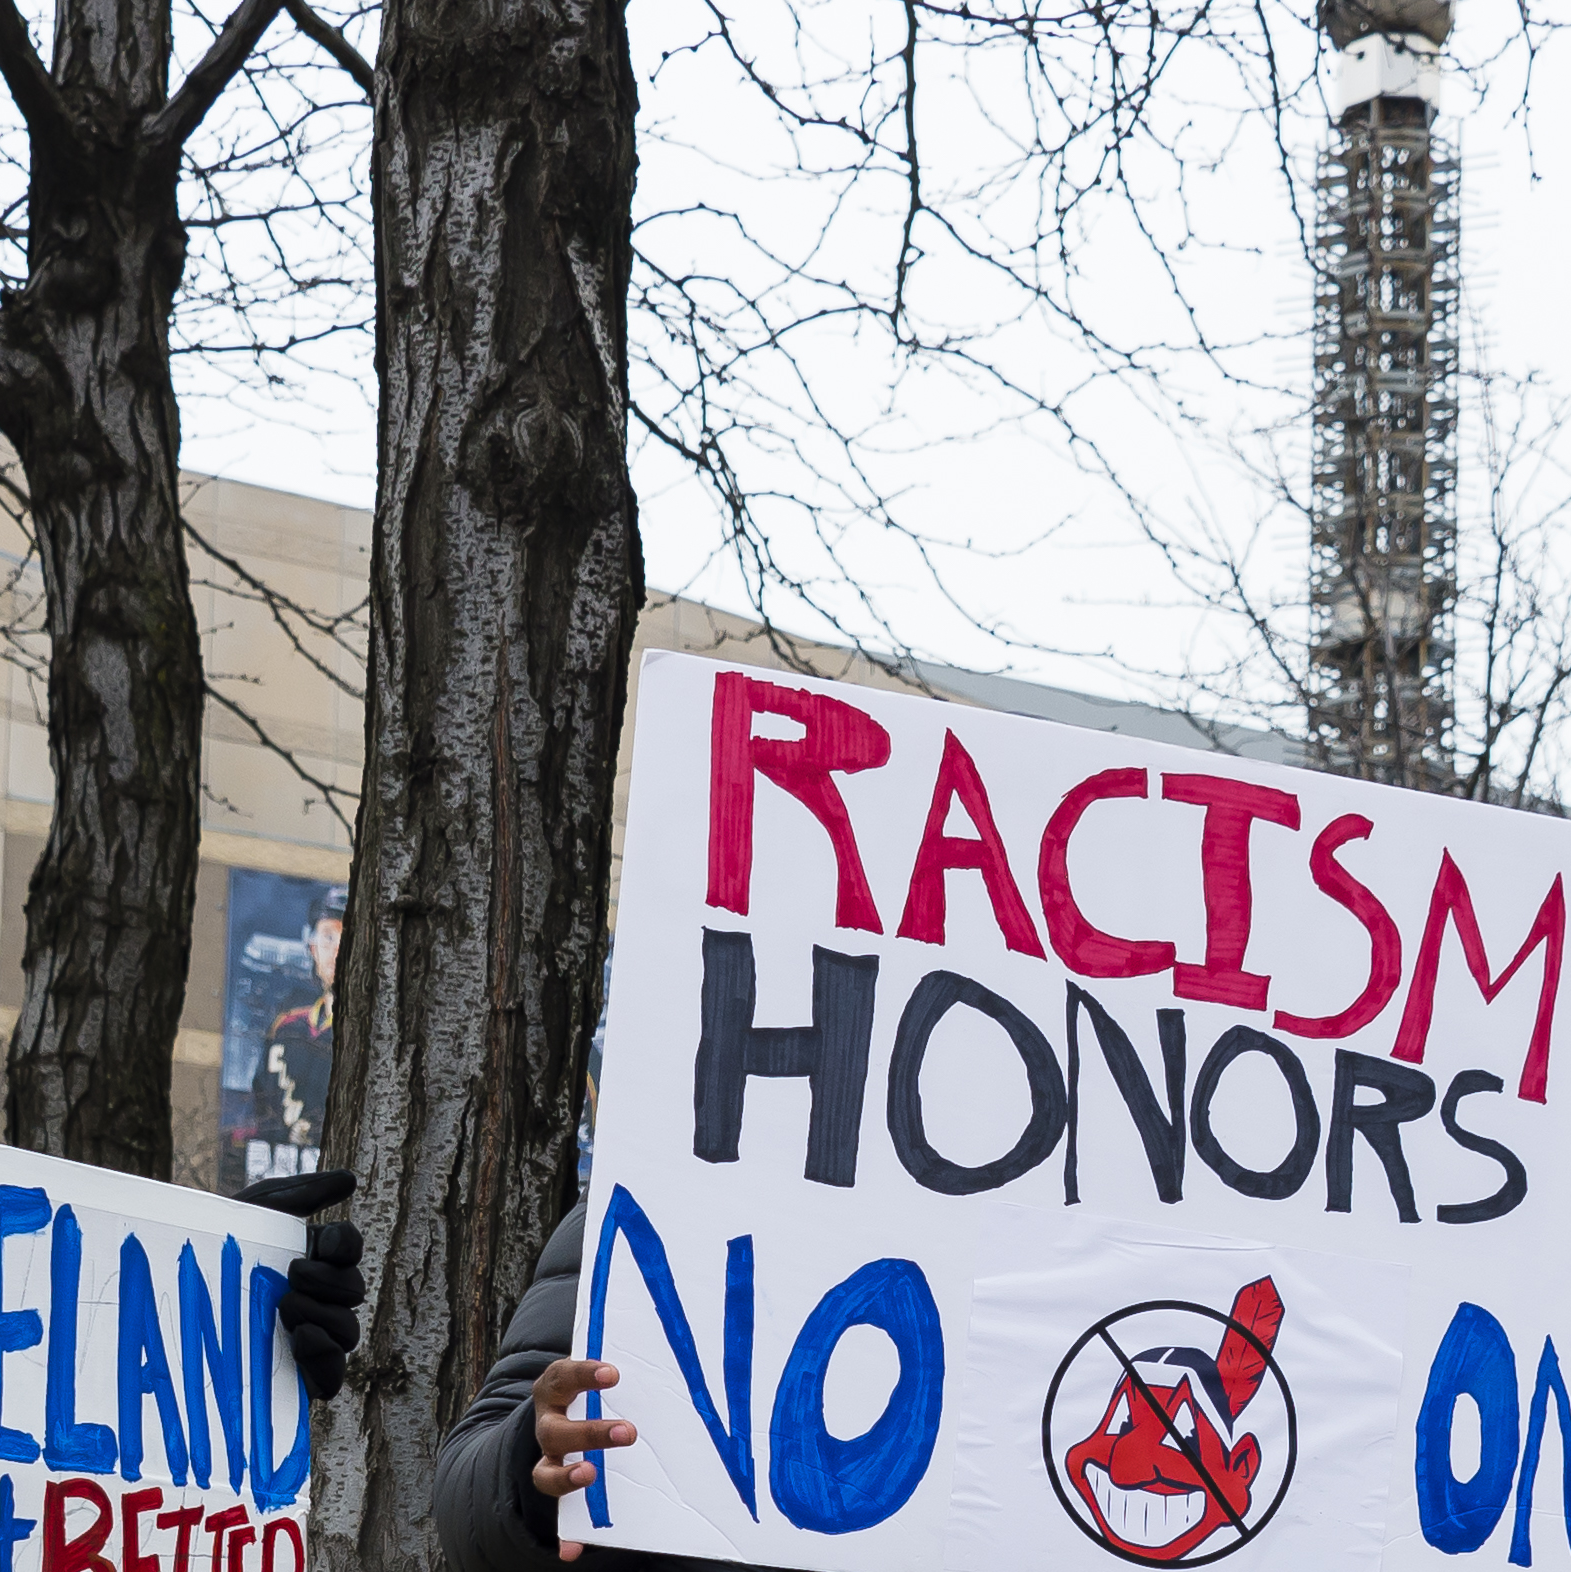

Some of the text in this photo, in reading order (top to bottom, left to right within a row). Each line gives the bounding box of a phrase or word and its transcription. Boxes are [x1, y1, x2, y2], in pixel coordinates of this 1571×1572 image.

[705, 671, 1567, 1105] RACISM
[692, 925, 1530, 1226] HONORS
[582, 1183, 947, 1537] NO
